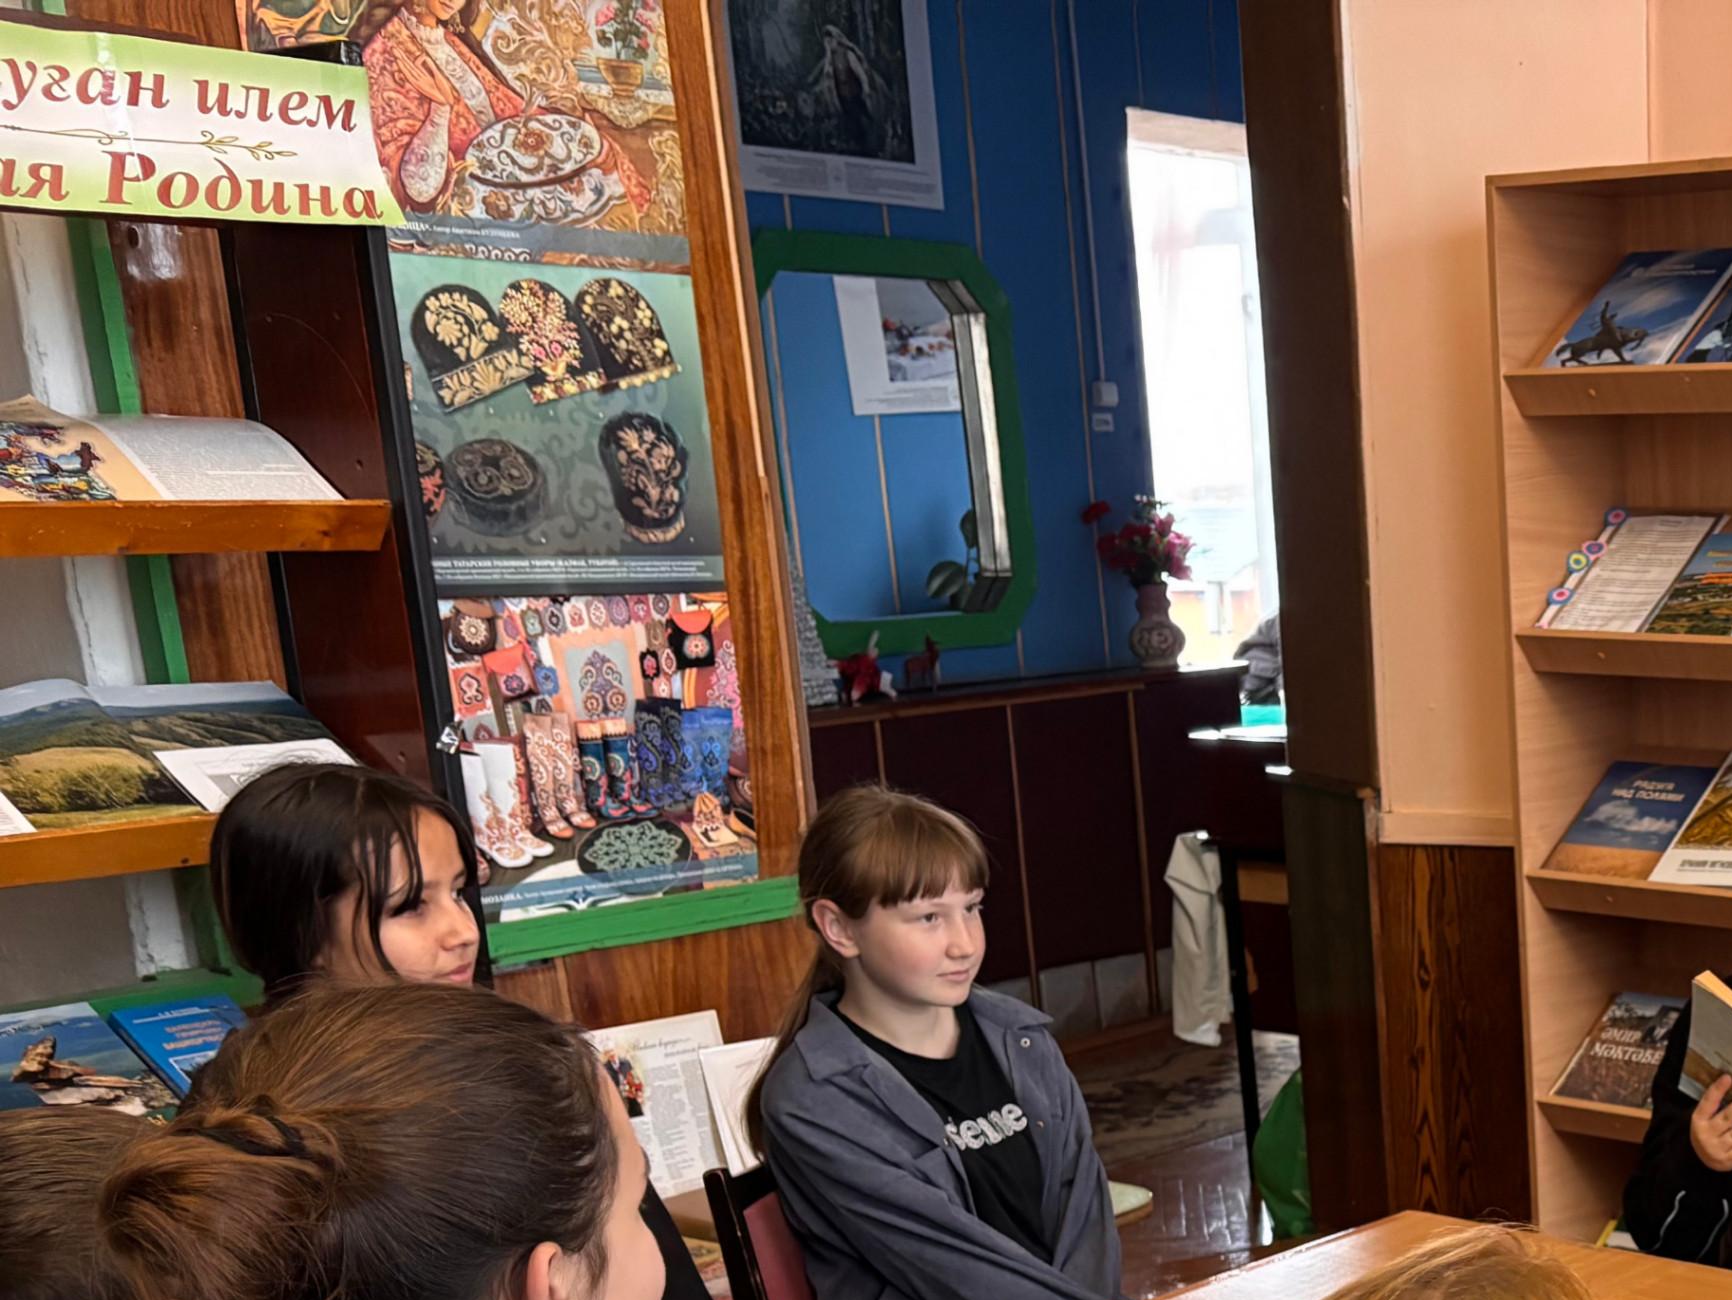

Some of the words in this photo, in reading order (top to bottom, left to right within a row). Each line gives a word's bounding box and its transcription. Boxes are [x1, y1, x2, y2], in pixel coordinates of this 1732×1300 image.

[0, 57, 170, 111] уған
[193, 78, 357, 132] илем
[99, 150, 384, 220] Родина
